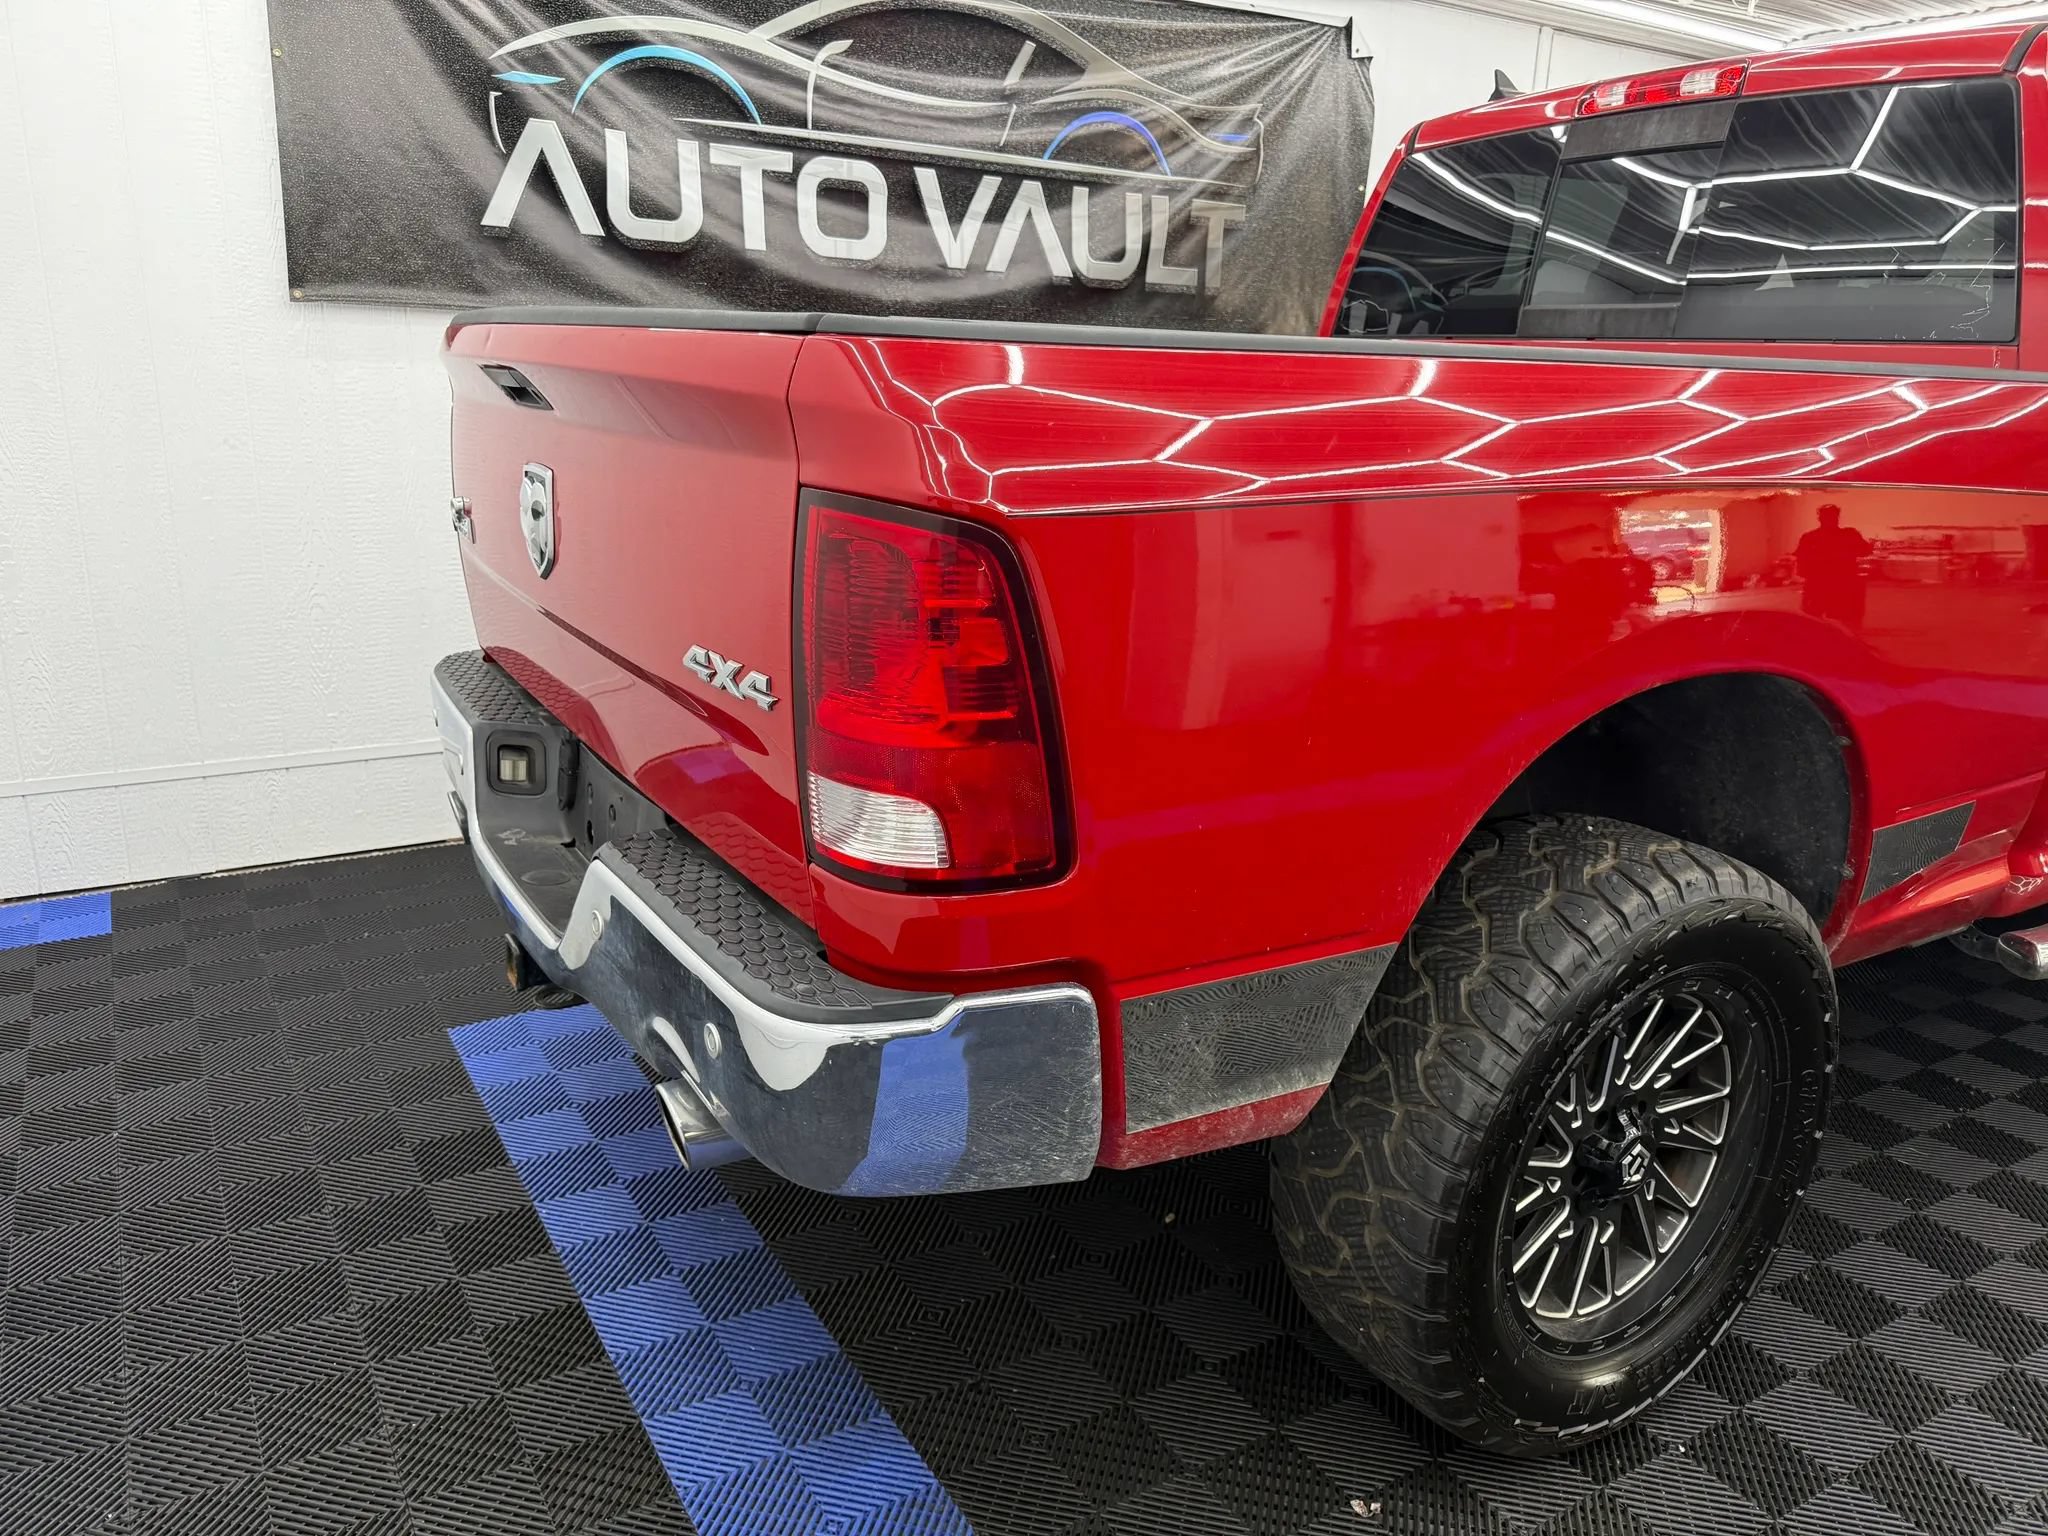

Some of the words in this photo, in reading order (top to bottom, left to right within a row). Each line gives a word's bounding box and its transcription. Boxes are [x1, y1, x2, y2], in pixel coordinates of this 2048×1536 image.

[479, 117, 888, 261] AUTO
[914, 166, 1247, 291] VAULT
[682, 644, 780, 711] 4X4
